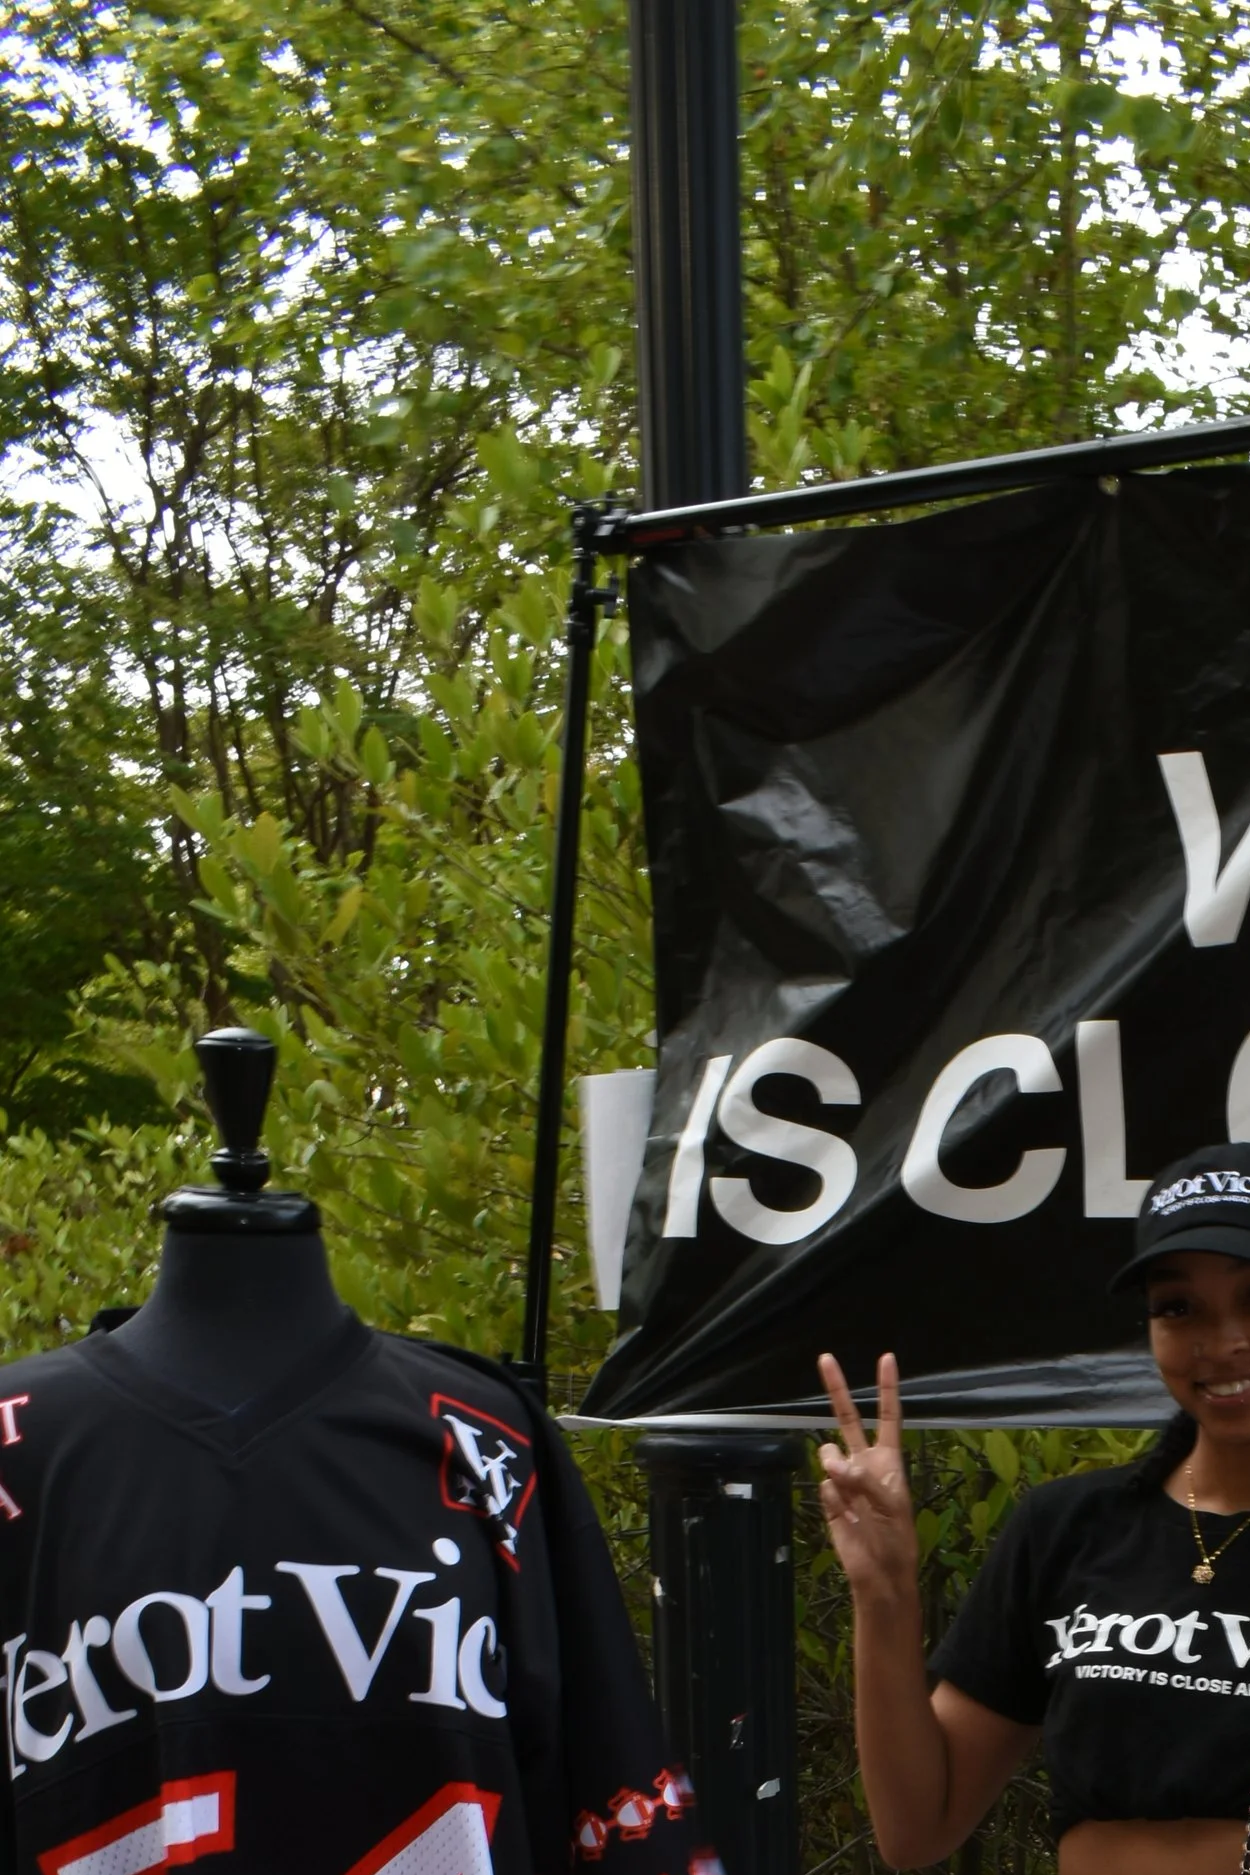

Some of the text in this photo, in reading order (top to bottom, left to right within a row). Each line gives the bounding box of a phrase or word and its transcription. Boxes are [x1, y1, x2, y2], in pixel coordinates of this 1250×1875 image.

[662, 1036, 862, 1246] IS
[1075, 1664, 1149, 1683] VICTORY
[1150, 1670, 1169, 1687] IS
[1170, 1675, 1233, 1697] CLOSE
